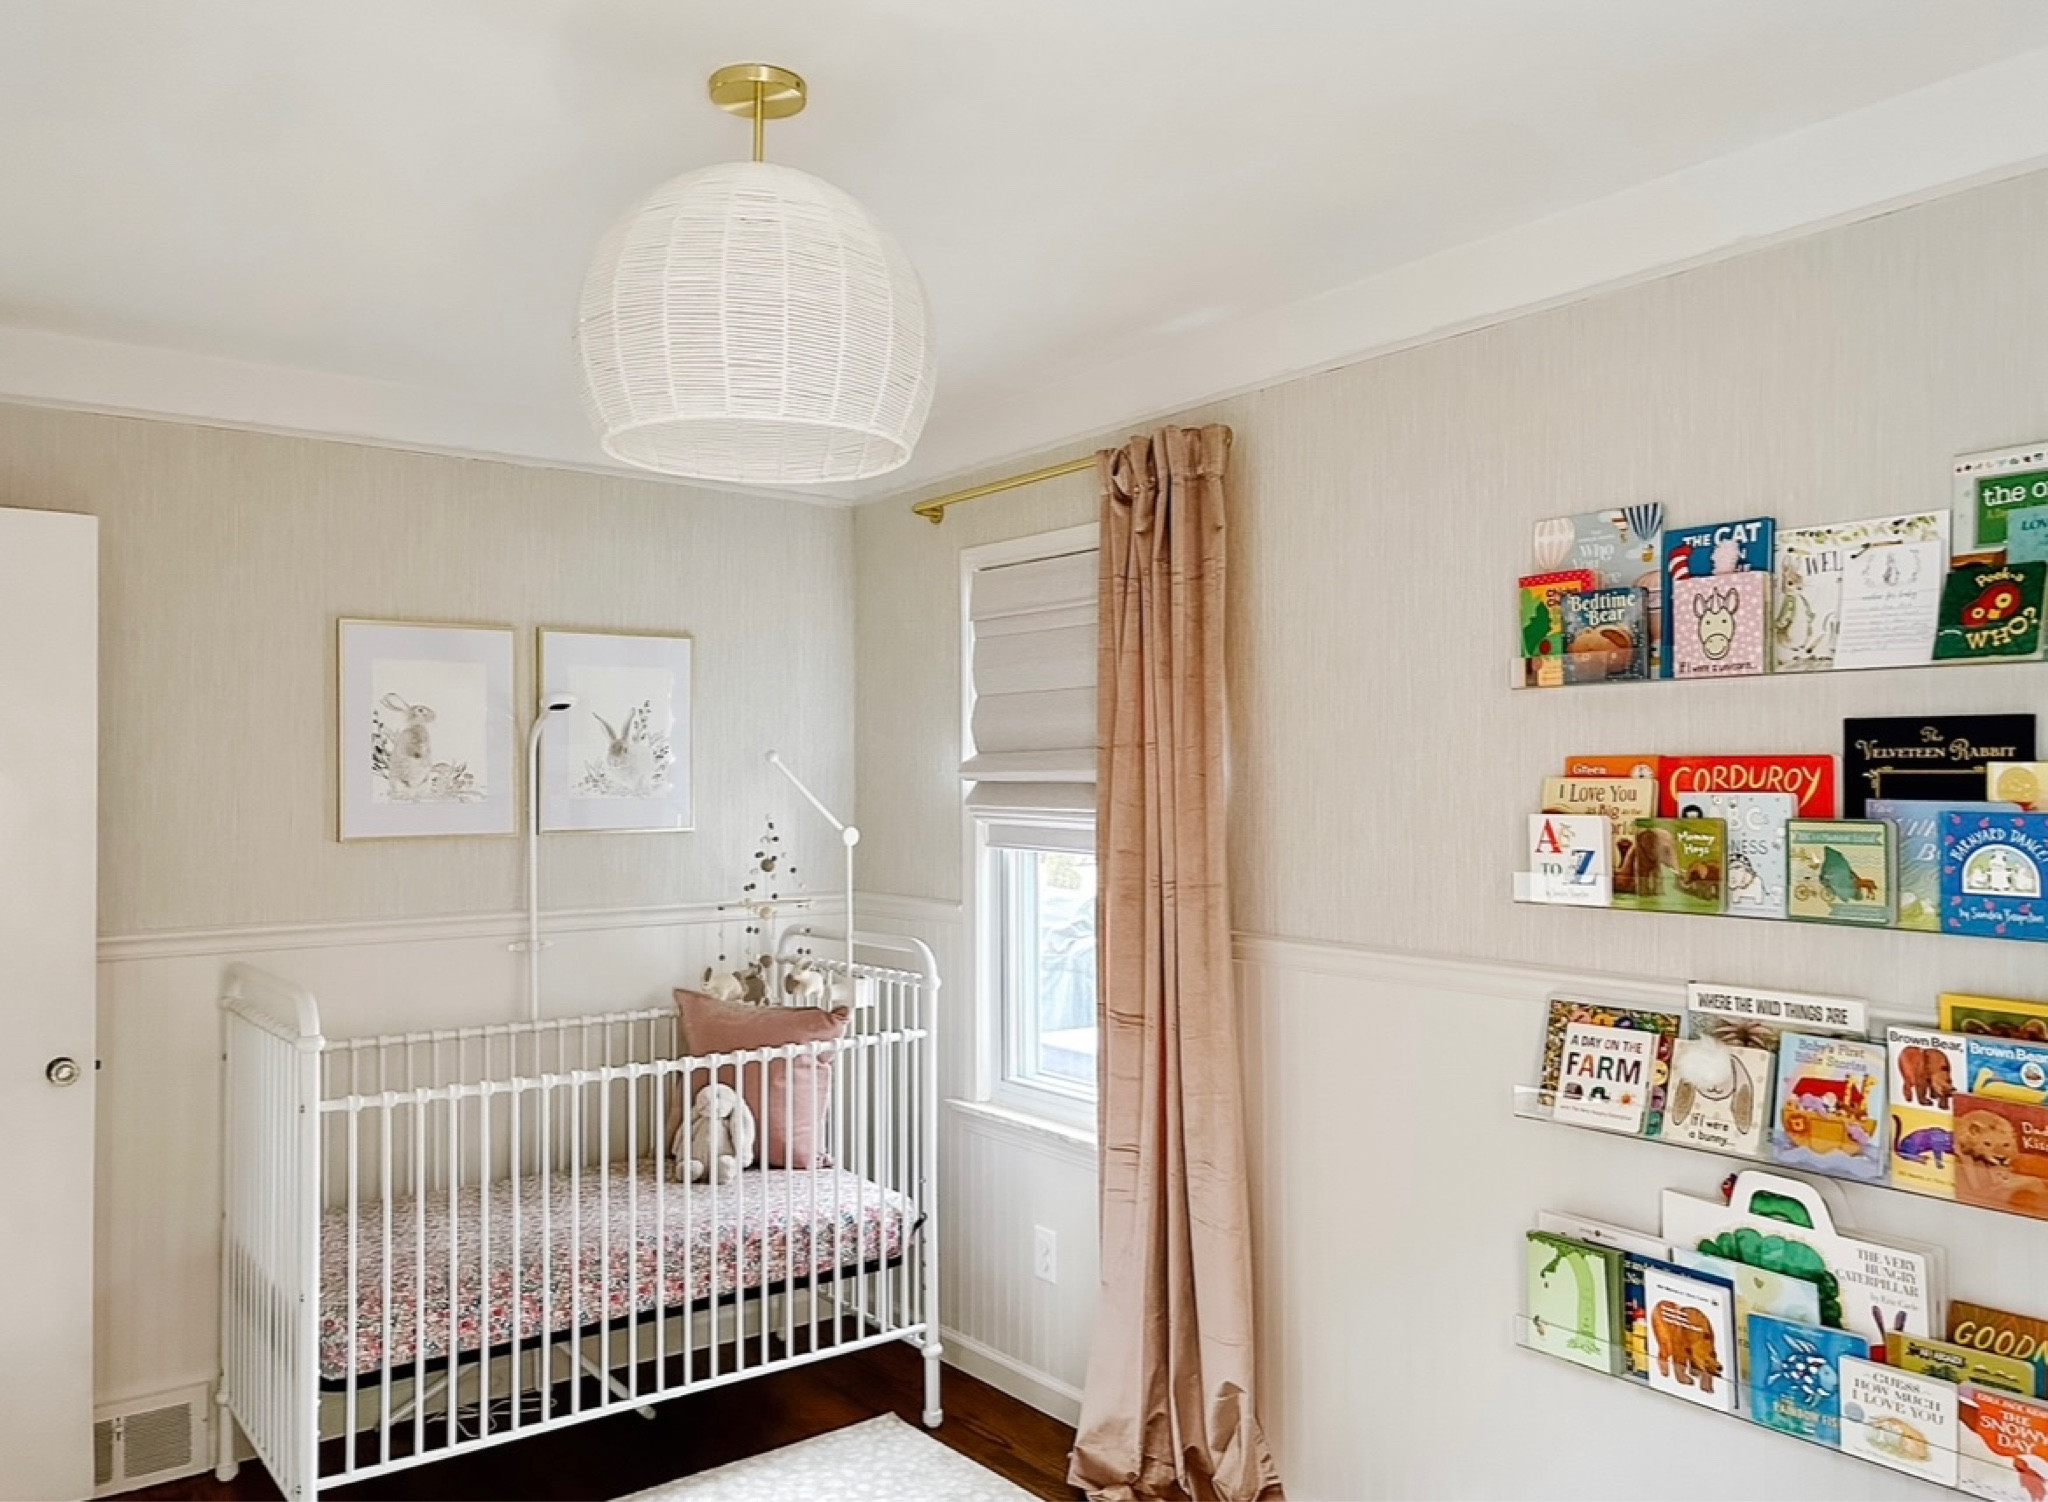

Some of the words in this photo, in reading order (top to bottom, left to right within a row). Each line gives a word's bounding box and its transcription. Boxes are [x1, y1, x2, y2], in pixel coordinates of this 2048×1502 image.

[1982, 485, 2026, 507] the
[1682, 533, 1711, 548] THE
[1714, 521, 1762, 546] CAT
[1569, 592, 1637, 613] Bedtime
[1586, 608, 1626, 626] Bear
[1965, 606, 2038, 650] WHO?
[1950, 738, 2017, 762] RABBIT
[1569, 783, 1606, 803] Love
[1610, 785, 1638, 802] You
[1535, 819, 1563, 854] A
[1541, 862, 1563, 876] TO
[1568, 848, 1598, 887] Z
[1697, 992, 1733, 1011] WHERE
[1734, 996, 1754, 1013] THE
[1756, 998, 1782, 1016] WILD
[1783, 1002, 1824, 1022] THINGS
[1825, 1007, 1849, 1025] ARE
[1570, 1034, 1579, 1046] A
[1581, 1035, 1602, 1049] DAY
[1604, 1038, 1620, 1051] ON
[1622, 1040, 1643, 1055] THE
[1889, 1031, 1930, 1047] Brown
[1566, 1051, 1643, 1086] FARM
[1857, 1247, 1883, 1264] THE
[1883, 1253, 1917, 1273] VERY
[1834, 1267, 1920, 1298] CATERPILLAR
[1865, 1262, 1917, 1285] HUNGRY
[1854, 1377, 1889, 1396] HOW
[1894, 1389, 1941, 1412] MUCH
[1873, 1373, 1920, 1392] GUESS
[1863, 1392, 1907, 1415] LOVE
[1909, 1405, 1944, 1425] YOU
[2001, 1410, 2031, 1427] THE
[1997, 1433, 2034, 1455] DAY
